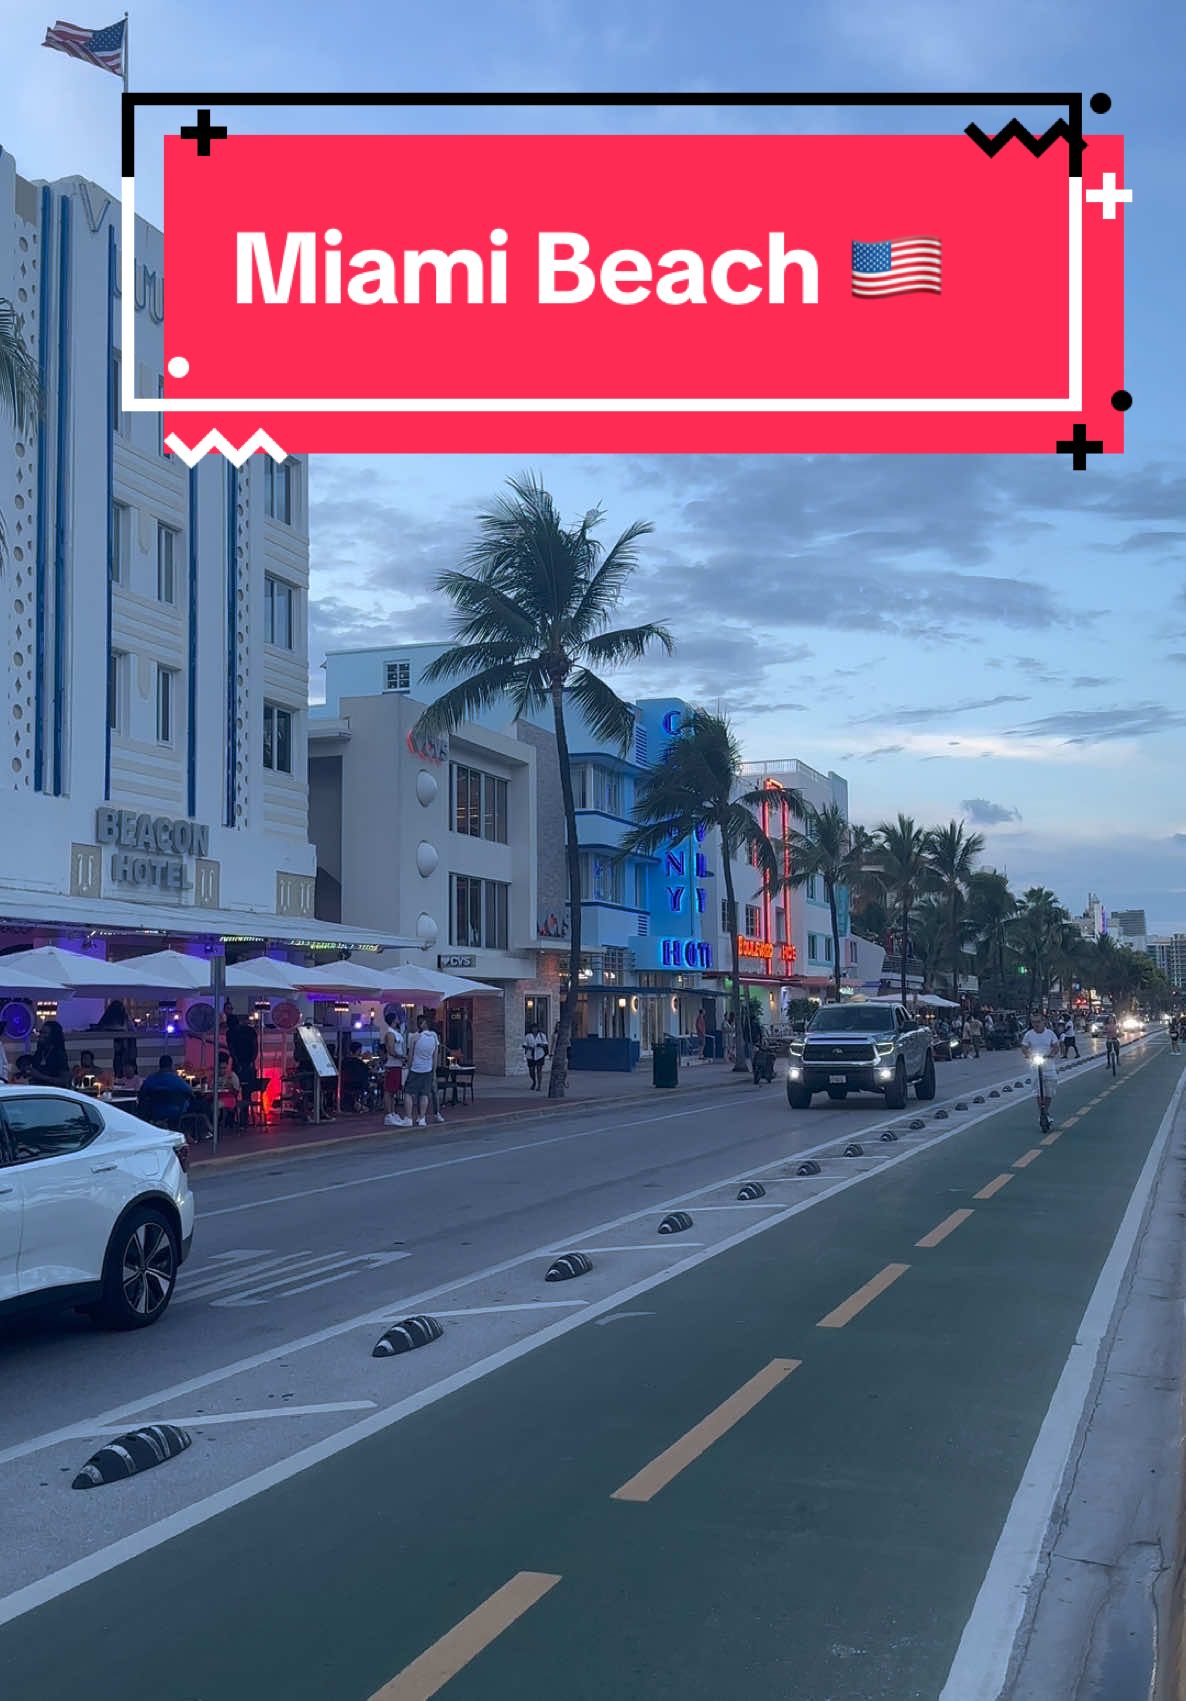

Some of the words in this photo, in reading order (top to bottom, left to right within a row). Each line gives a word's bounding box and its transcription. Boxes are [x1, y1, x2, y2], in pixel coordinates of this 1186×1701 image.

[96, 806, 209, 857] BEACON
[111, 853, 194, 890] HOTEL
[450, 955, 472, 967] CVS
